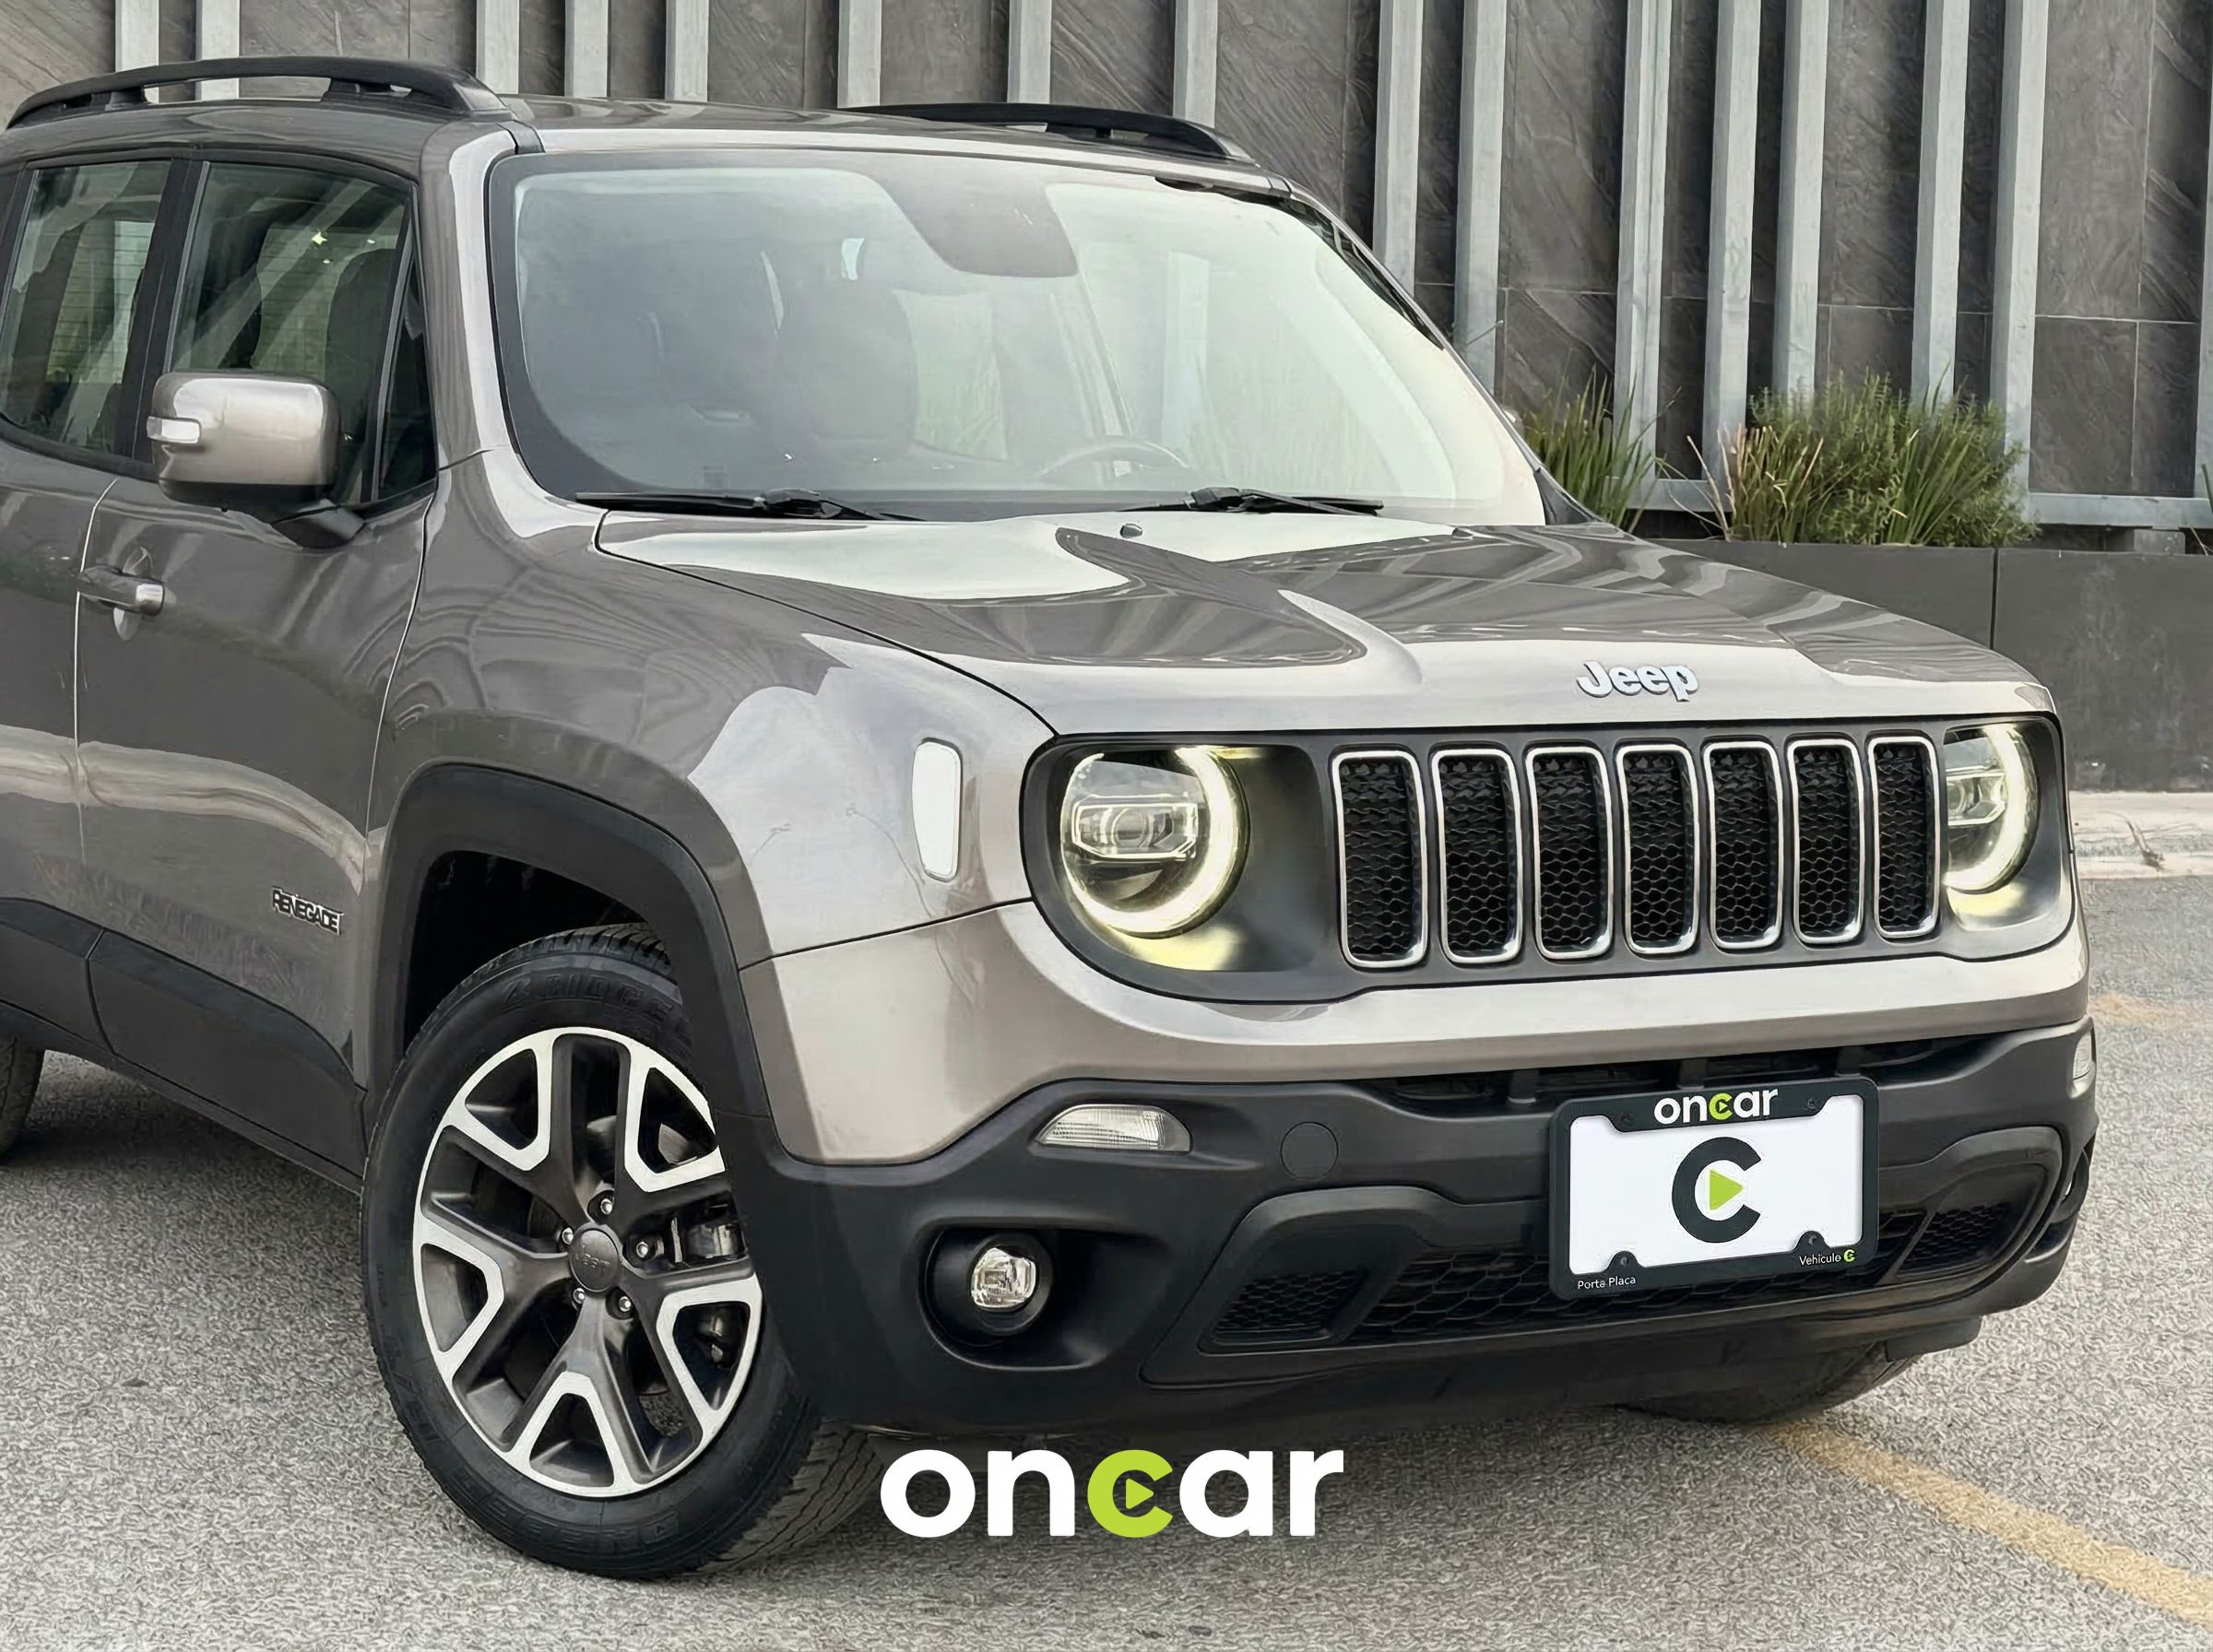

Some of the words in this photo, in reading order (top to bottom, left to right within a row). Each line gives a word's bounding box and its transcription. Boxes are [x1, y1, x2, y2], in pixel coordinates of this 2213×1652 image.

[1576, 660, 1699, 702] Jeep
[271, 886, 345, 937] RENEGADE
[1653, 1088, 1779, 1125] oncar
[1577, 1279, 1605, 1291] Porta
[1608, 1276, 1637, 1289] Placa
